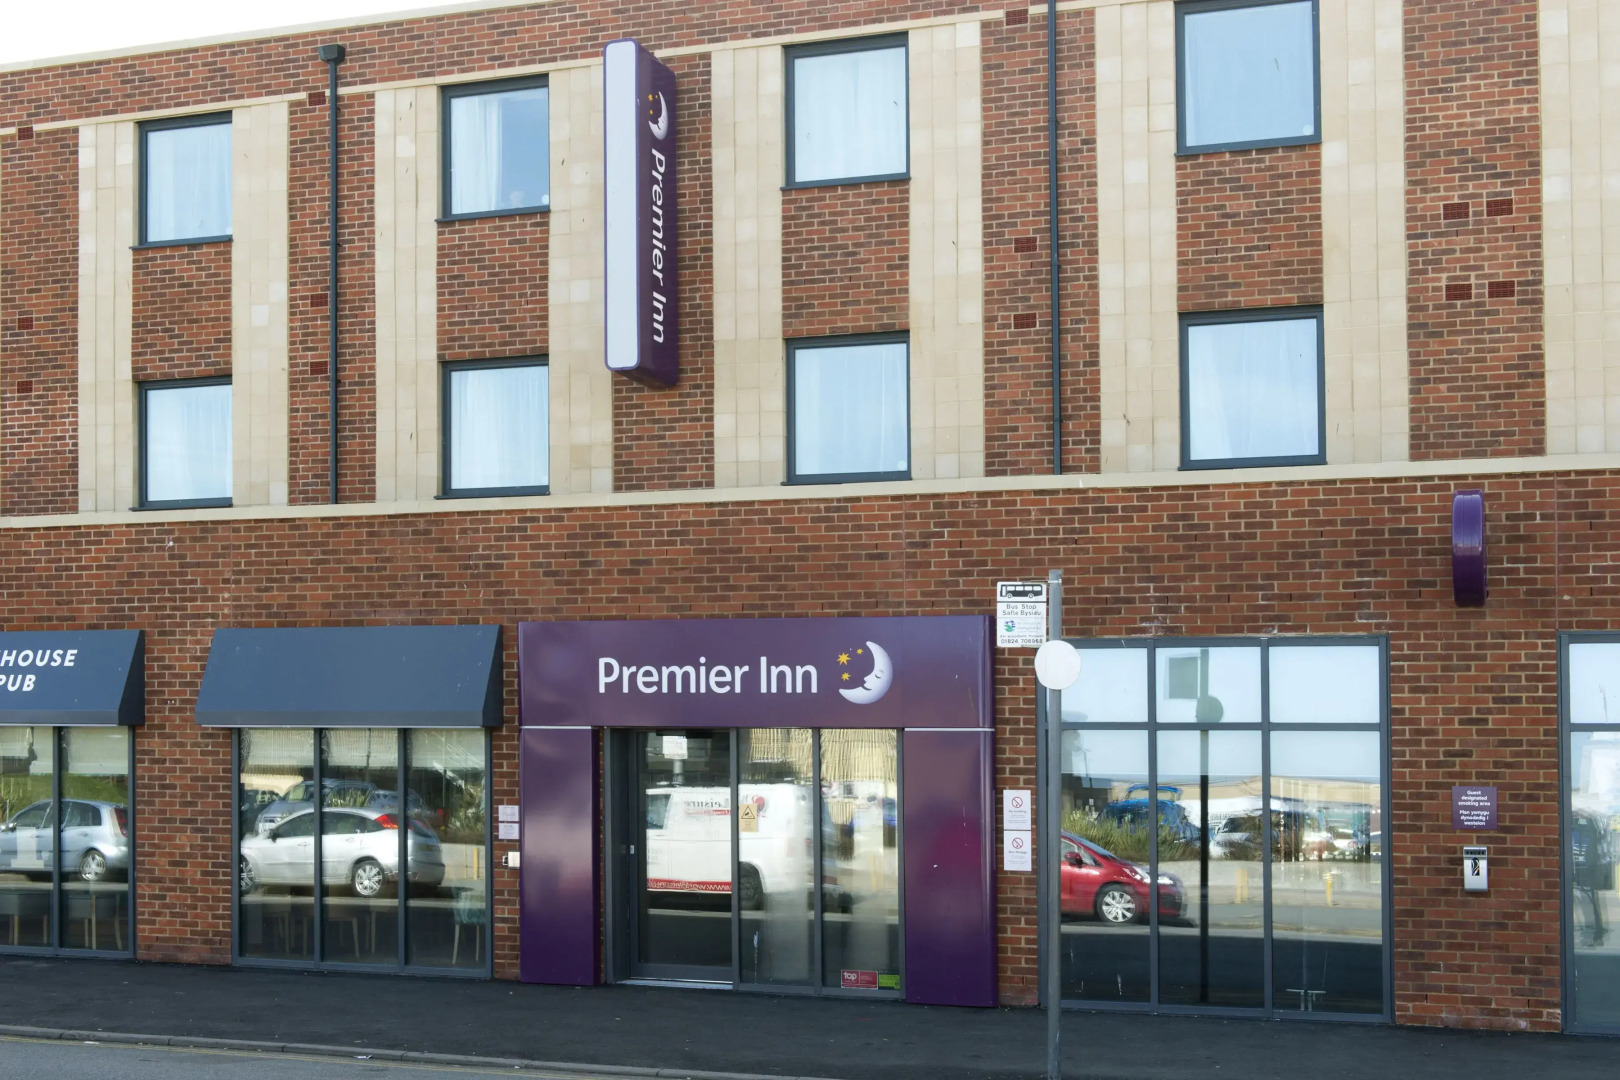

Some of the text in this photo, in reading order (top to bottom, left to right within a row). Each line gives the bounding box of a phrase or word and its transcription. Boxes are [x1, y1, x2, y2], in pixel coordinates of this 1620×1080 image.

[652, 148, 667, 343] Premier Inn
[0, 649, 78, 667] HOUSE
[0, 674, 36, 692] PUB
[599, 656, 818, 694] Premier Inn
